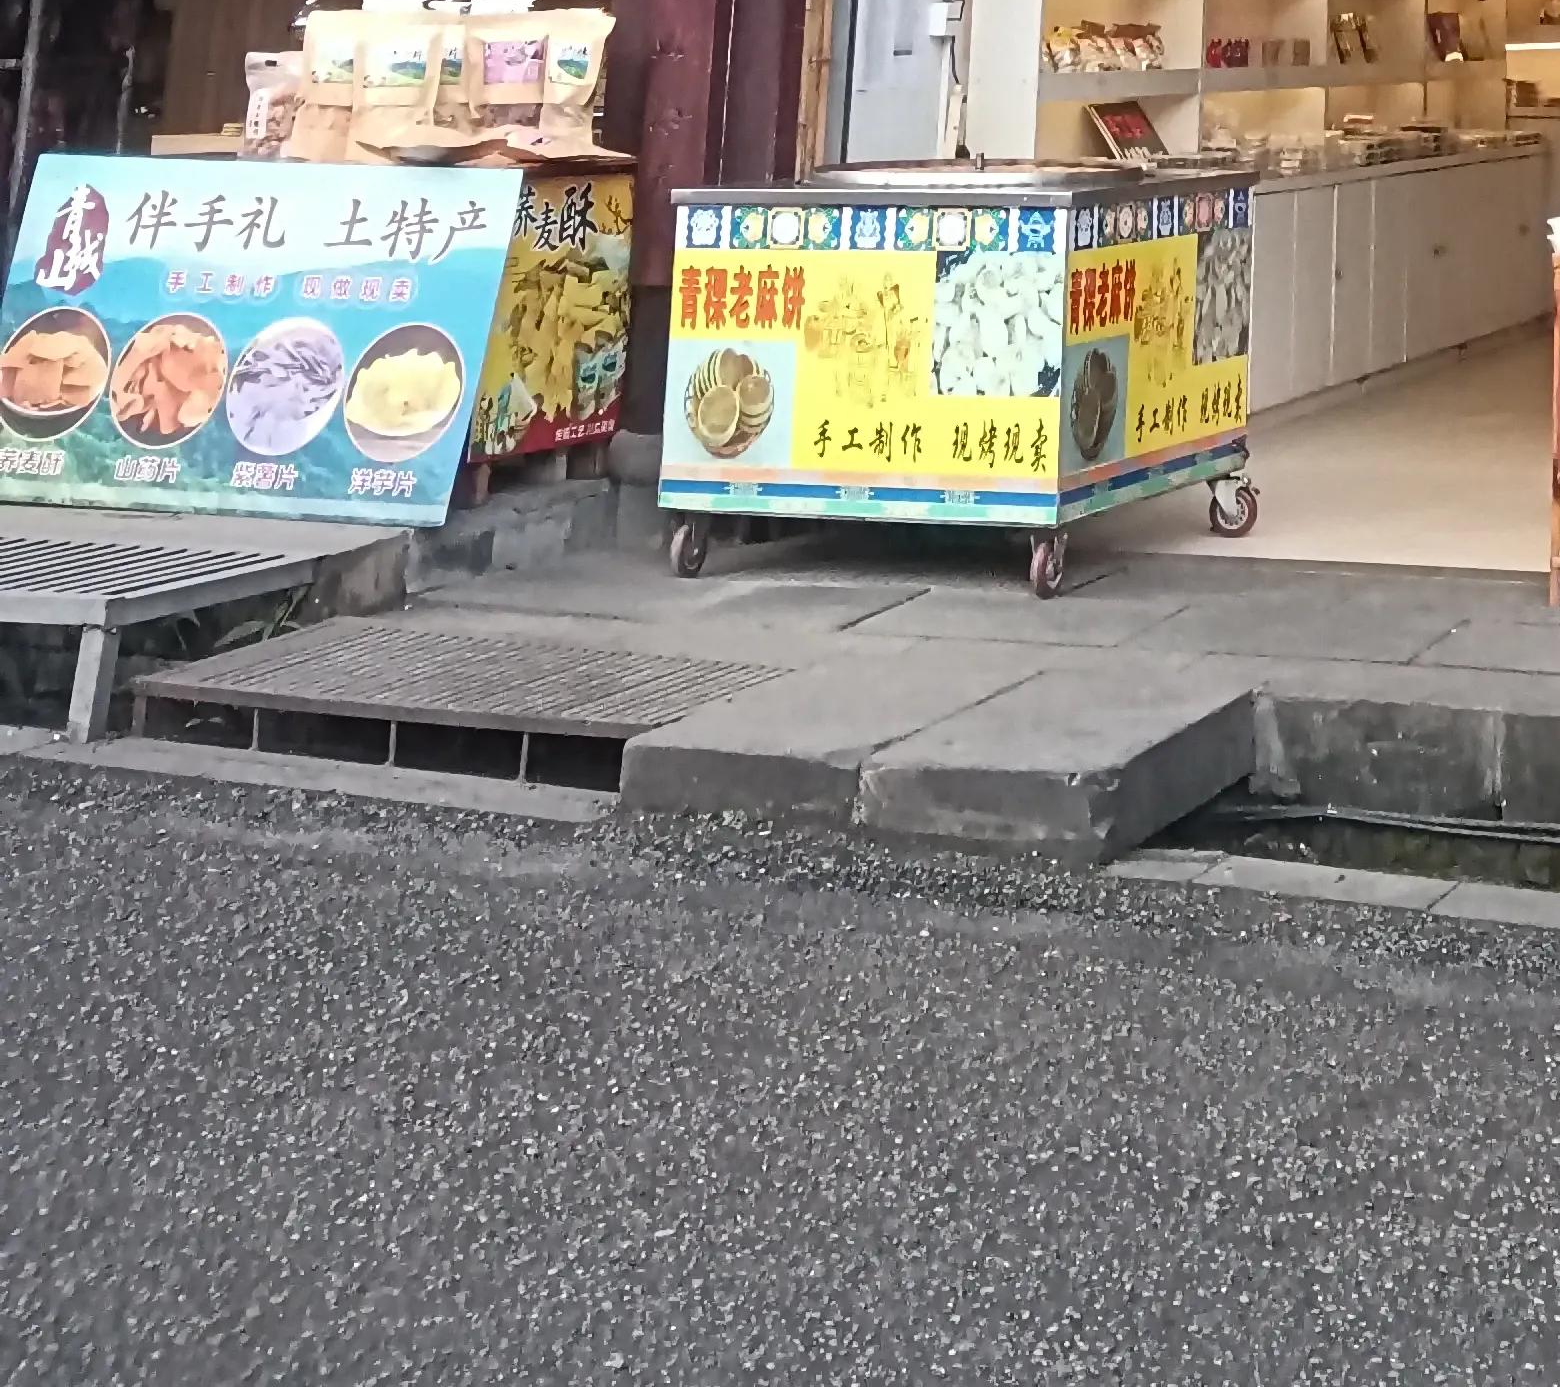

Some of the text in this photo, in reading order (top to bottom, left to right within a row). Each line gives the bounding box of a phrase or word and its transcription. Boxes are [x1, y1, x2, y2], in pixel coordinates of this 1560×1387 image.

[126, 189, 488, 262] 伴手礼 土特产
[166, 269, 274, 298] 手工制作
[679, 263, 806, 331] 青稞老麻饼
[1069, 258, 1137, 336] 青稞老麻饼
[1135, 394, 1188, 443] 手工制作
[114, 455, 182, 484] 山药片
[813, 418, 1047, 473] 手工制作 现烤现卖
[230, 461, 300, 491] 紫薯片
[347, 467, 418, 497] 洋芋片
